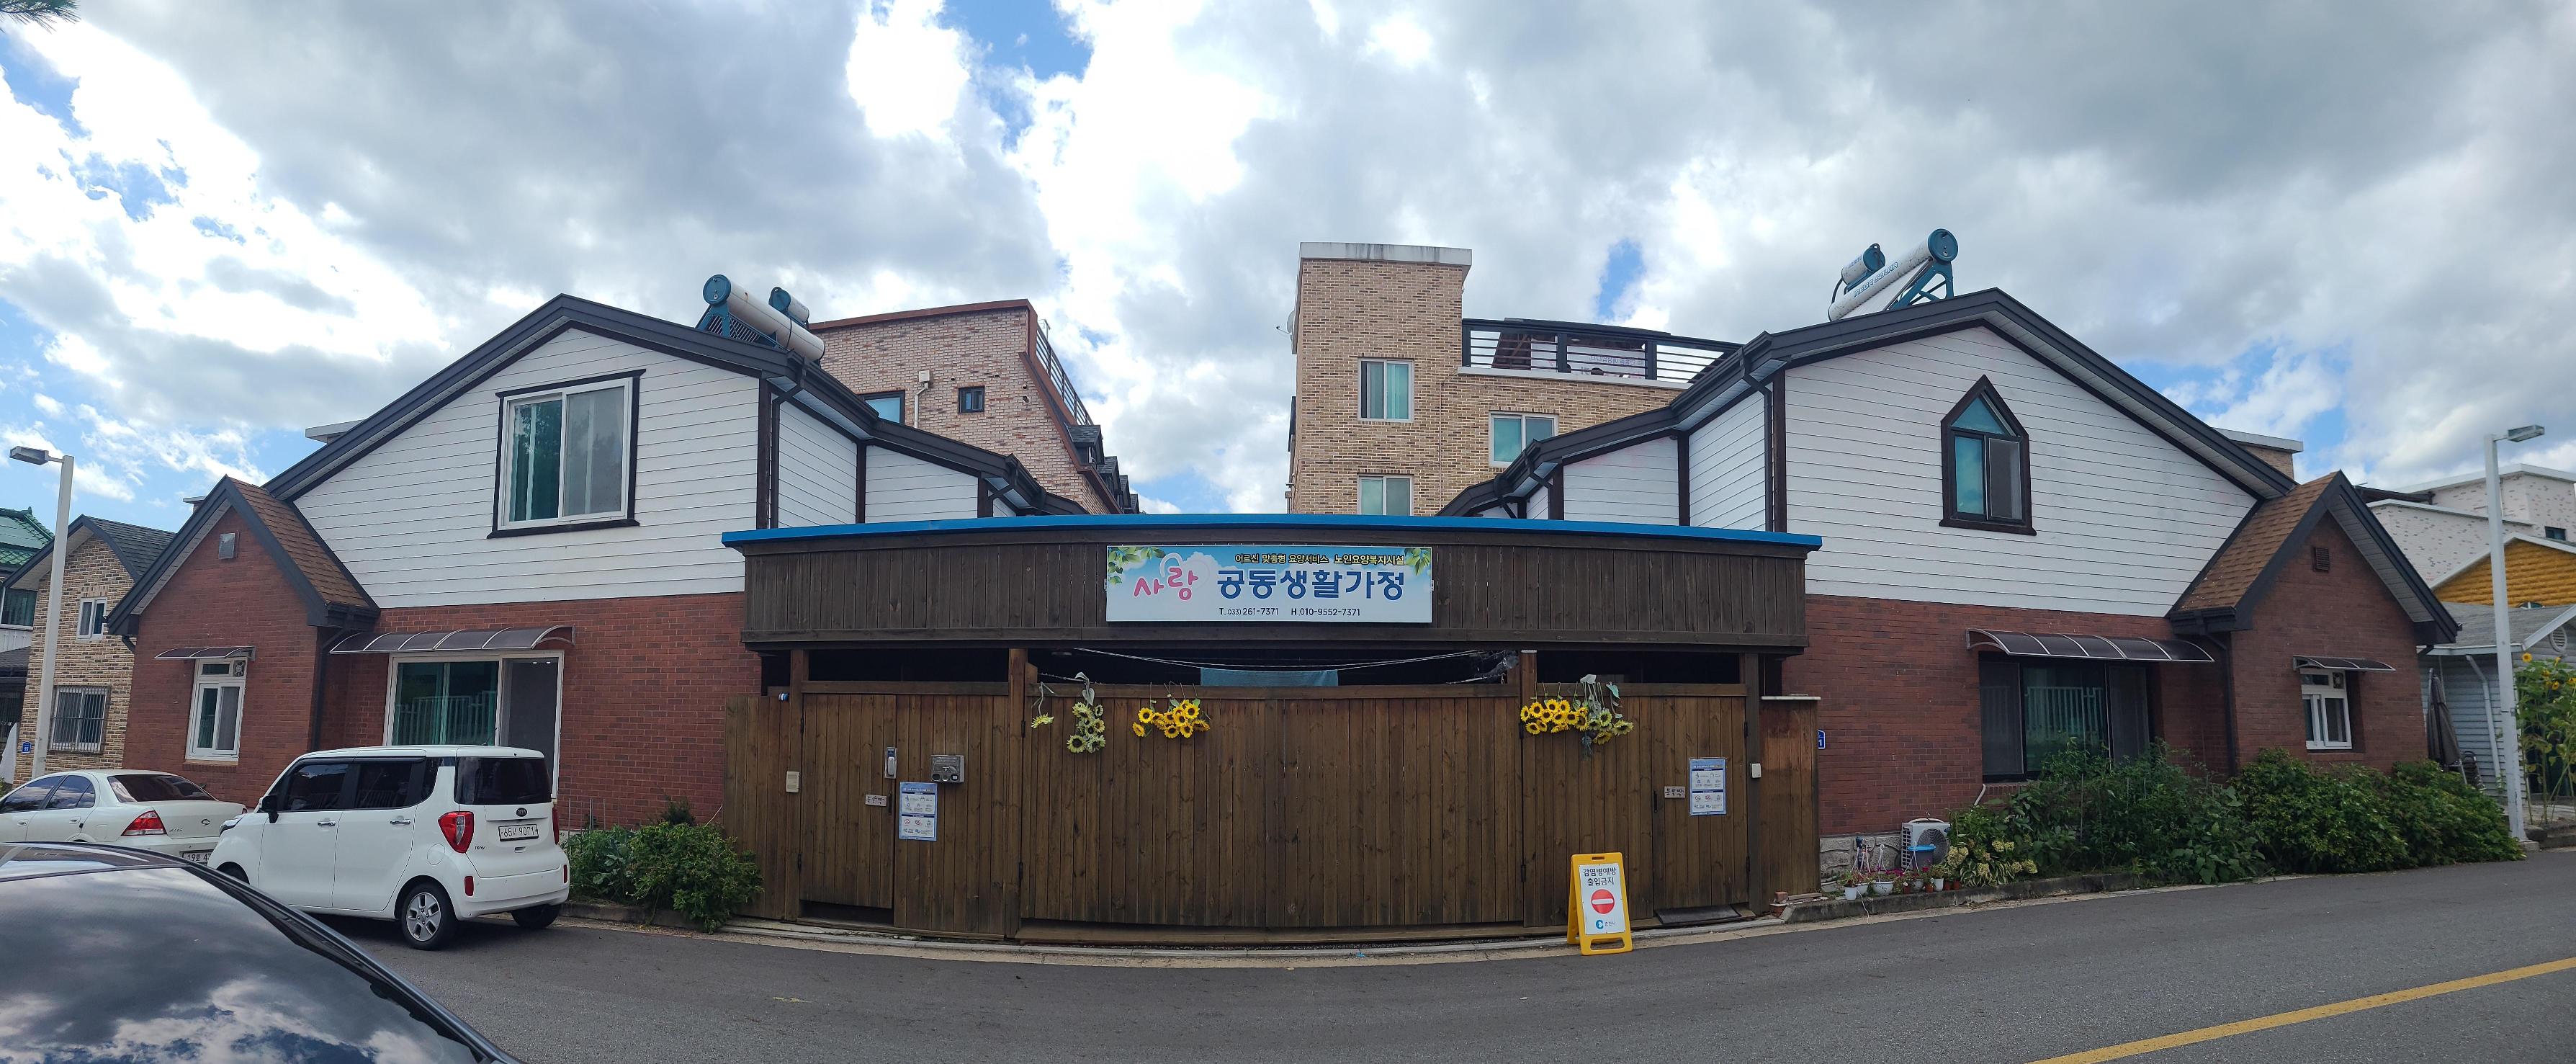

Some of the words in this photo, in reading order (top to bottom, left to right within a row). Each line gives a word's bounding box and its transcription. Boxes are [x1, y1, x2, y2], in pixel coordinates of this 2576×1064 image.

[1874, 261, 1898, 284] SOLAR
[1235, 554, 1260, 563] 어르신
[1262, 554, 1286, 563] 맞춤형
[1288, 554, 1329, 565] 요양서비스
[1334, 554, 1405, 565] 노인요양복지시설
[1134, 567, 1199, 601] 사랑
[1217, 569, 1404, 601] 공동생활가정
[1583, 867, 1617, 877] 감염병예방
[1587, 877, 1615, 887] 출입금지
